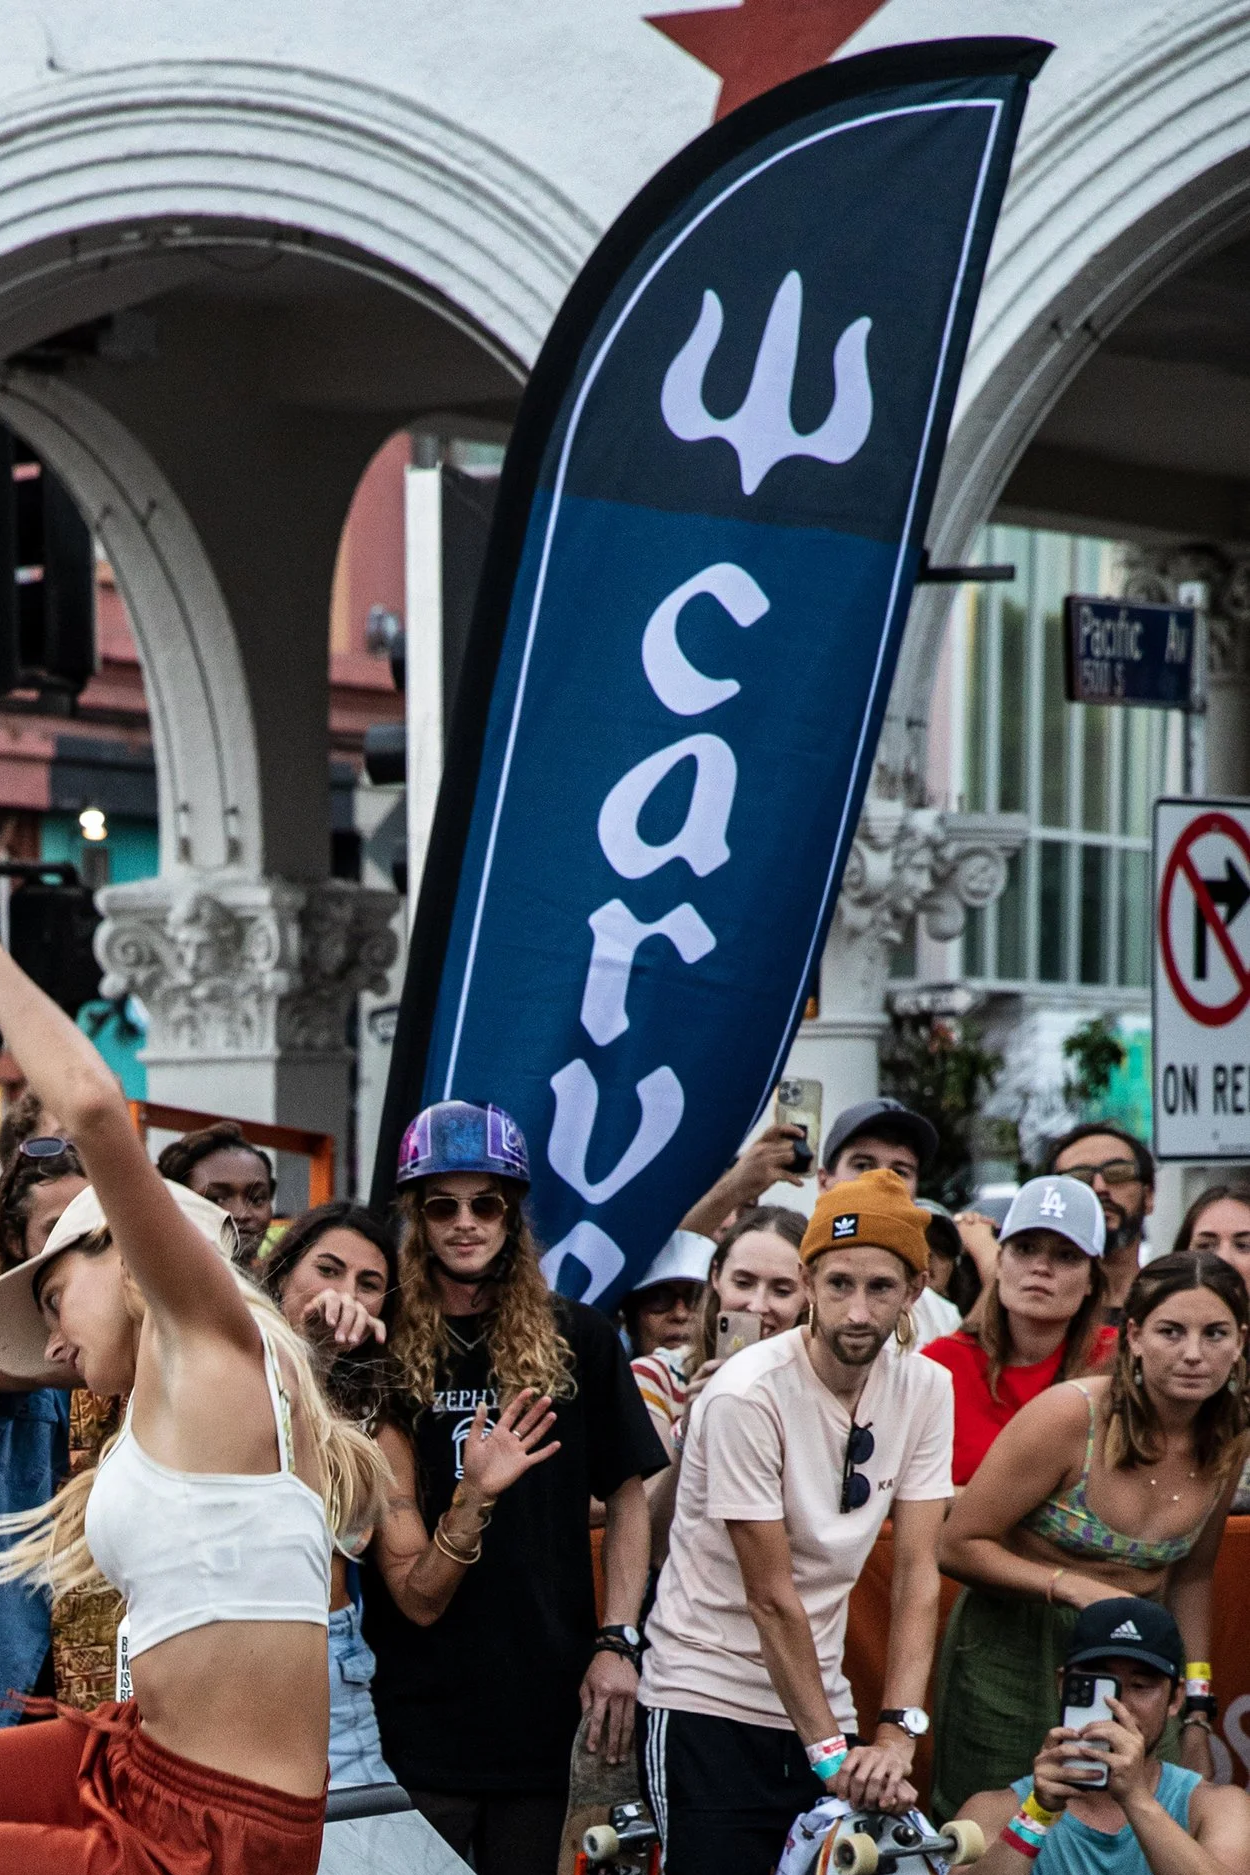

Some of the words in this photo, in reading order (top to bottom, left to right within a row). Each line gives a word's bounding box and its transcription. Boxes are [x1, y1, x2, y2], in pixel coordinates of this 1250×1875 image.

[1078, 605, 1143, 662] Pacific
[1163, 1063, 1199, 1116] ON
[1212, 1063, 1250, 1116] RE
[1039, 1185, 1067, 1219] LA
